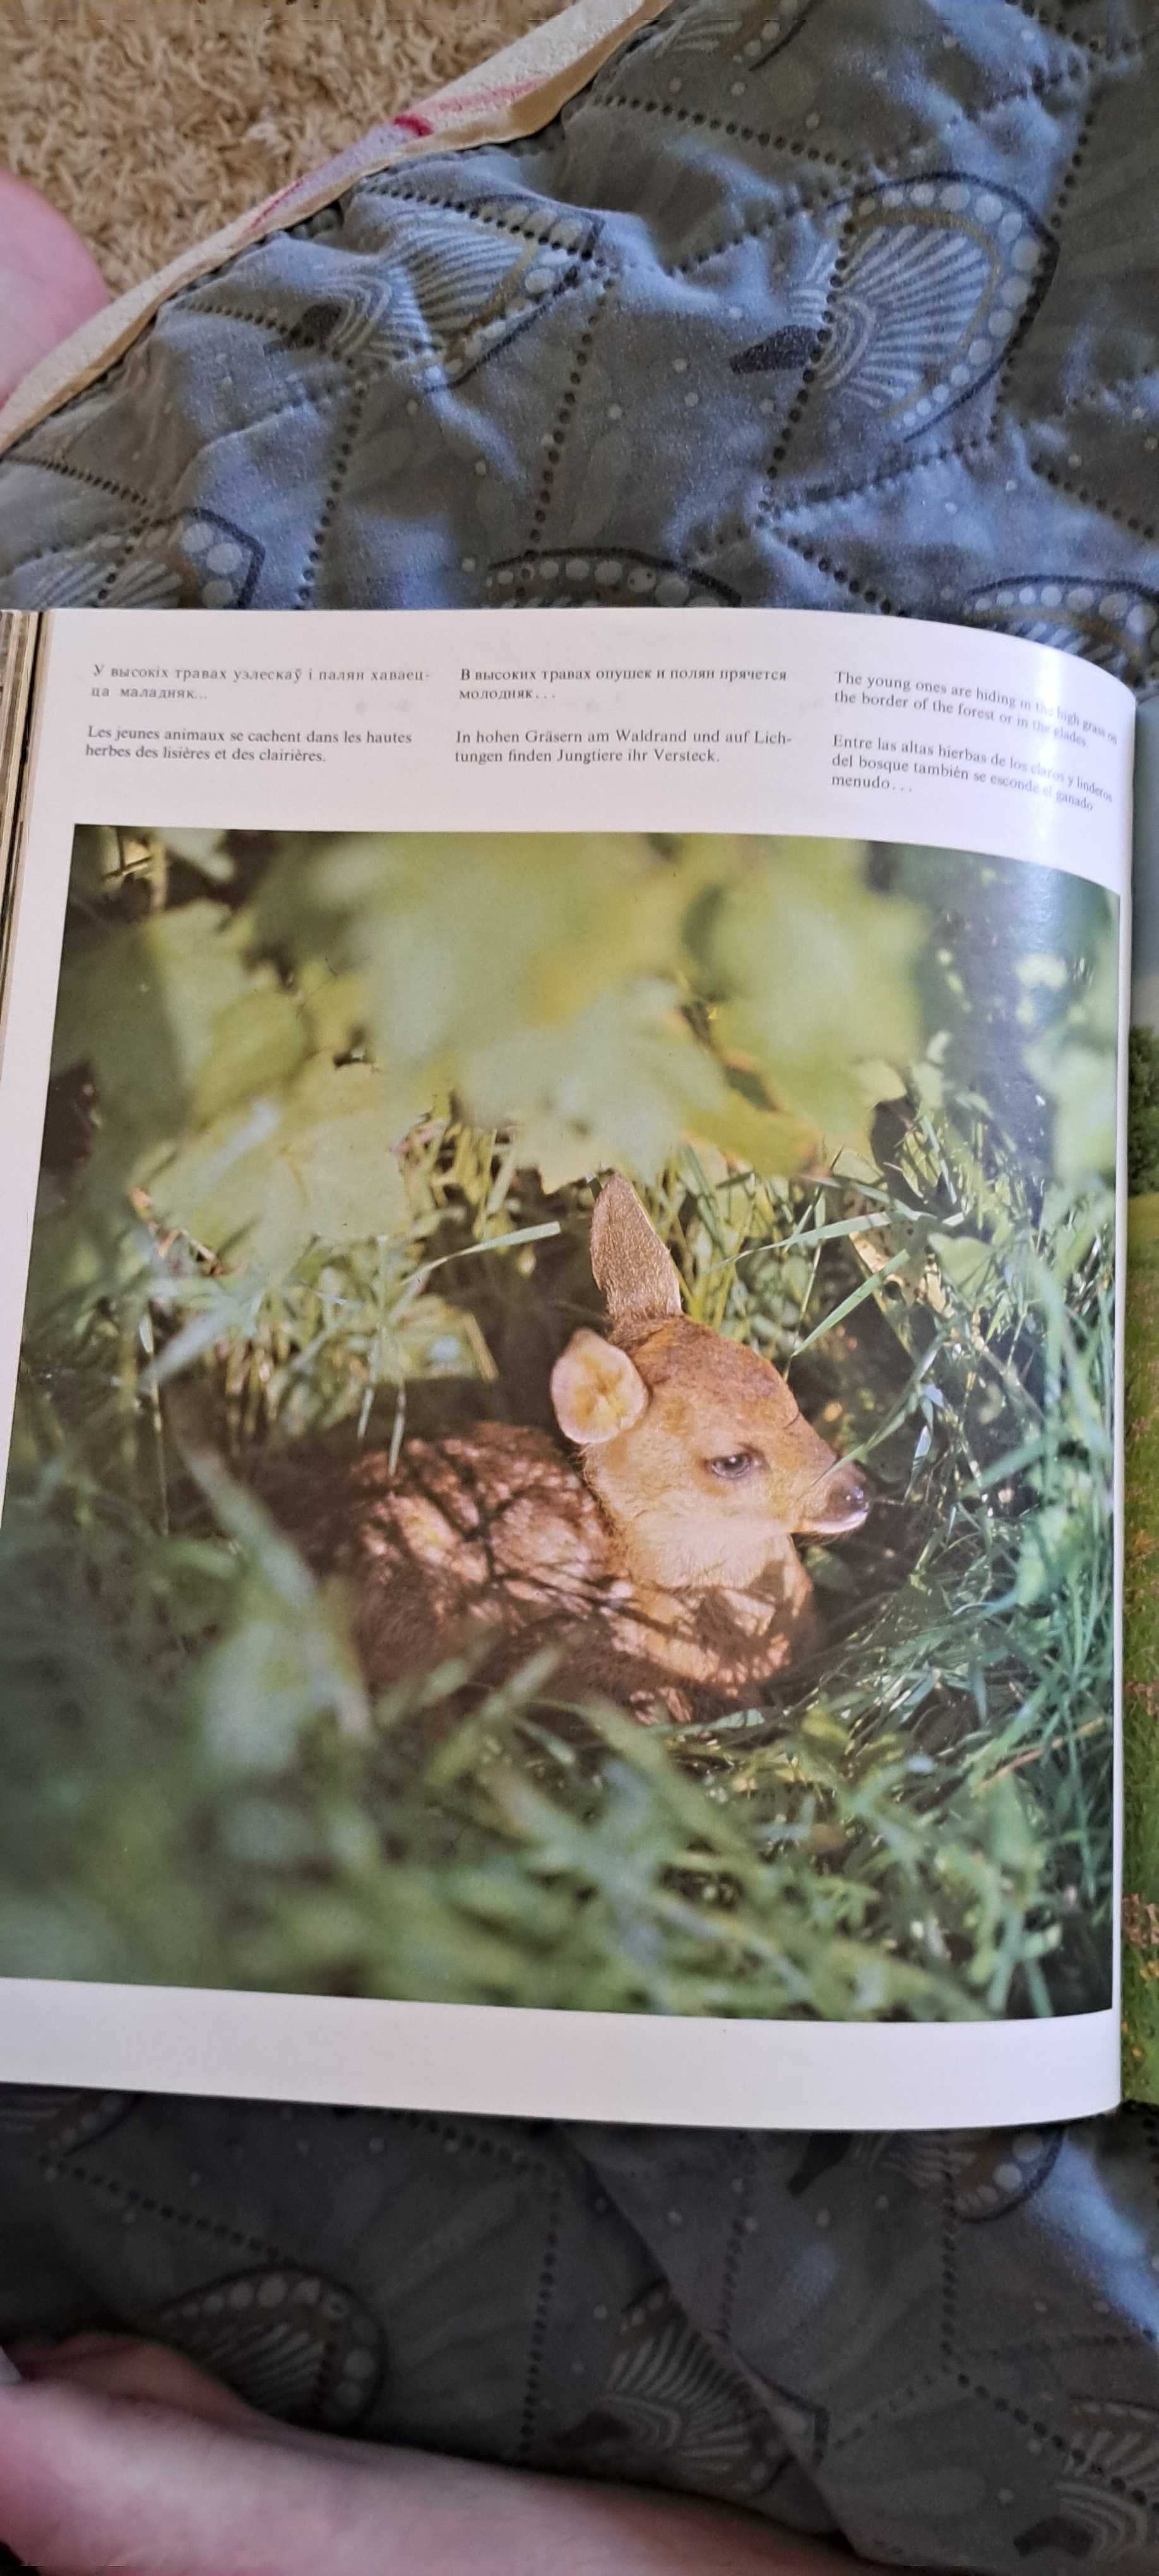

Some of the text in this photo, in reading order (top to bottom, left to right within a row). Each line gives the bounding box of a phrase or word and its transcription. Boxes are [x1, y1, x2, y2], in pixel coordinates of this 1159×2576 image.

[93, 664, 430, 684] У высокіх травах узлескаў і палян хаваец-
[460, 668, 787, 683] В высоких травах опушек и полян прячется
[91, 688, 110, 698] ца
[834, 671, 862, 686] The
[867, 676, 912, 693] young
[915, 682, 947, 695] ones
[951, 686, 972, 698] are
[977, 687, 1016, 708] hiding
[1020, 699, 1031, 711] in
[1057, 706, 1079, 726] high
[1083, 720, 1105, 738] grass
[1107, 732, 1117, 746] on
[834, 689, 857, 704] the
[862, 692, 909, 708] border
[913, 697, 929, 710] of
[932, 699, 954, 714] the
[958, 701, 994, 721] forest
[999, 714, 1012, 724] or
[1017, 717, 1028, 729] in
[1033, 720, 1050, 734] the
[87, 725, 412, 744] Les jeunes animaux se cachent dans les hautes
[456, 729, 793, 745] In hohen Gräsern am Waldrand und auf Lich-
[85, 743, 326, 762] herbes des lisières et des clairières.
[455, 747, 720, 766] tungen finden Jungtiere ihr Versteck.
[832, 734, 873, 750] Entre
[877, 737, 897, 752] las
[901, 739, 934, 756] altas
[938, 743, 987, 763] hierbas
[990, 753, 1006, 766] de
[1010, 756, 1028, 772] los
[1067, 775, 1074, 787] y
[1077, 775, 1113, 802] linderos
[831, 752, 853, 768] del
[859, 754, 909, 774] bosque
[913, 761, 969, 781] también
[973, 772, 986, 783] se
[990, 774, 1039, 794] esconde
[1055, 789, 1093, 811] ganado
